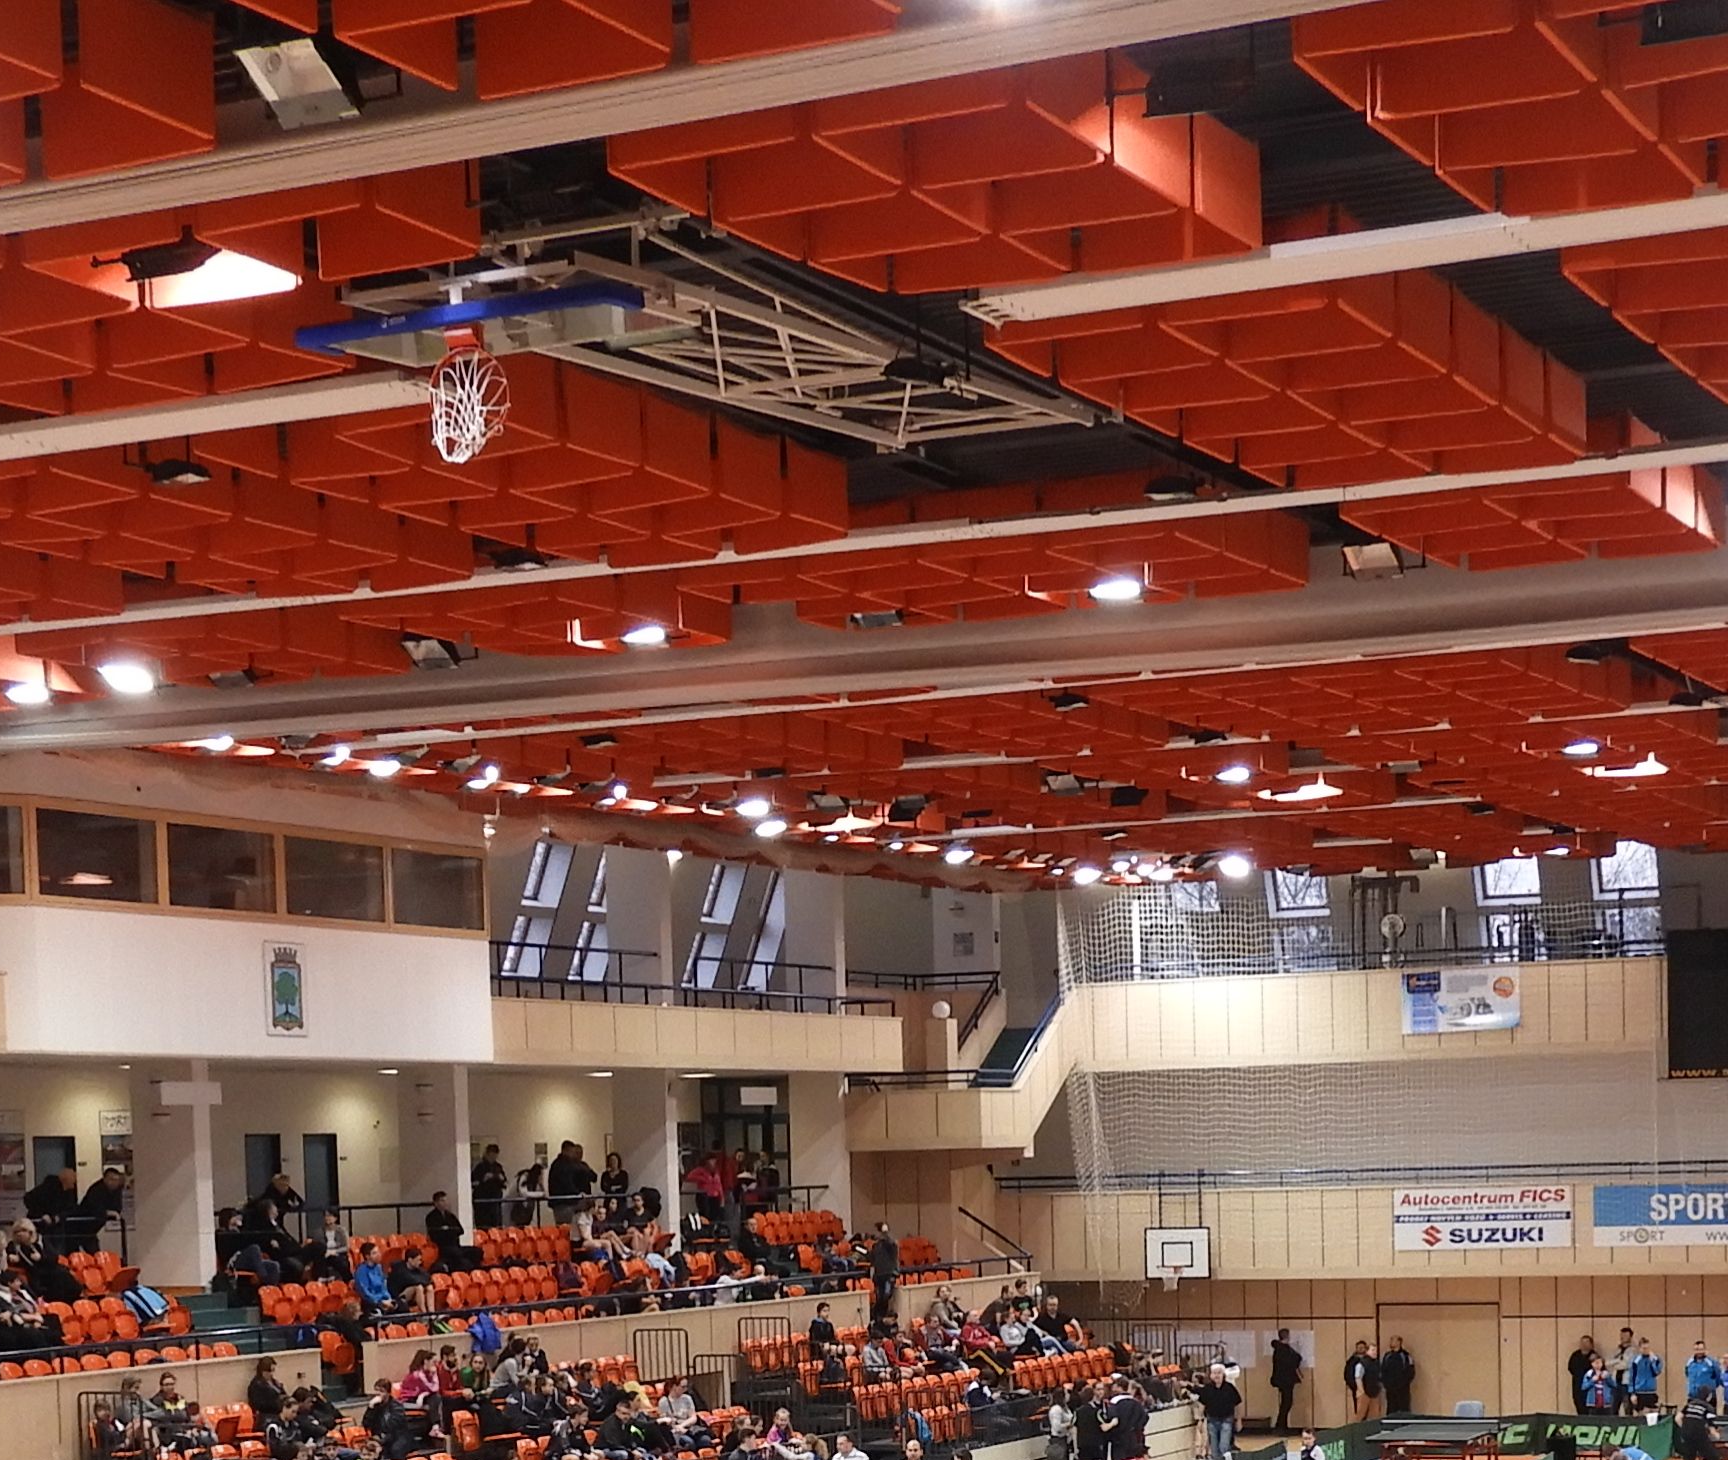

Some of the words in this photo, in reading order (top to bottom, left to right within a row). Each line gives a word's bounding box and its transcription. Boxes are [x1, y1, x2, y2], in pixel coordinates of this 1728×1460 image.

[1400, 1192, 1515, 1207] Autocentrum
[1518, 1188, 1566, 1204] FICS
[1449, 1226, 1544, 1244] SUZUKI
